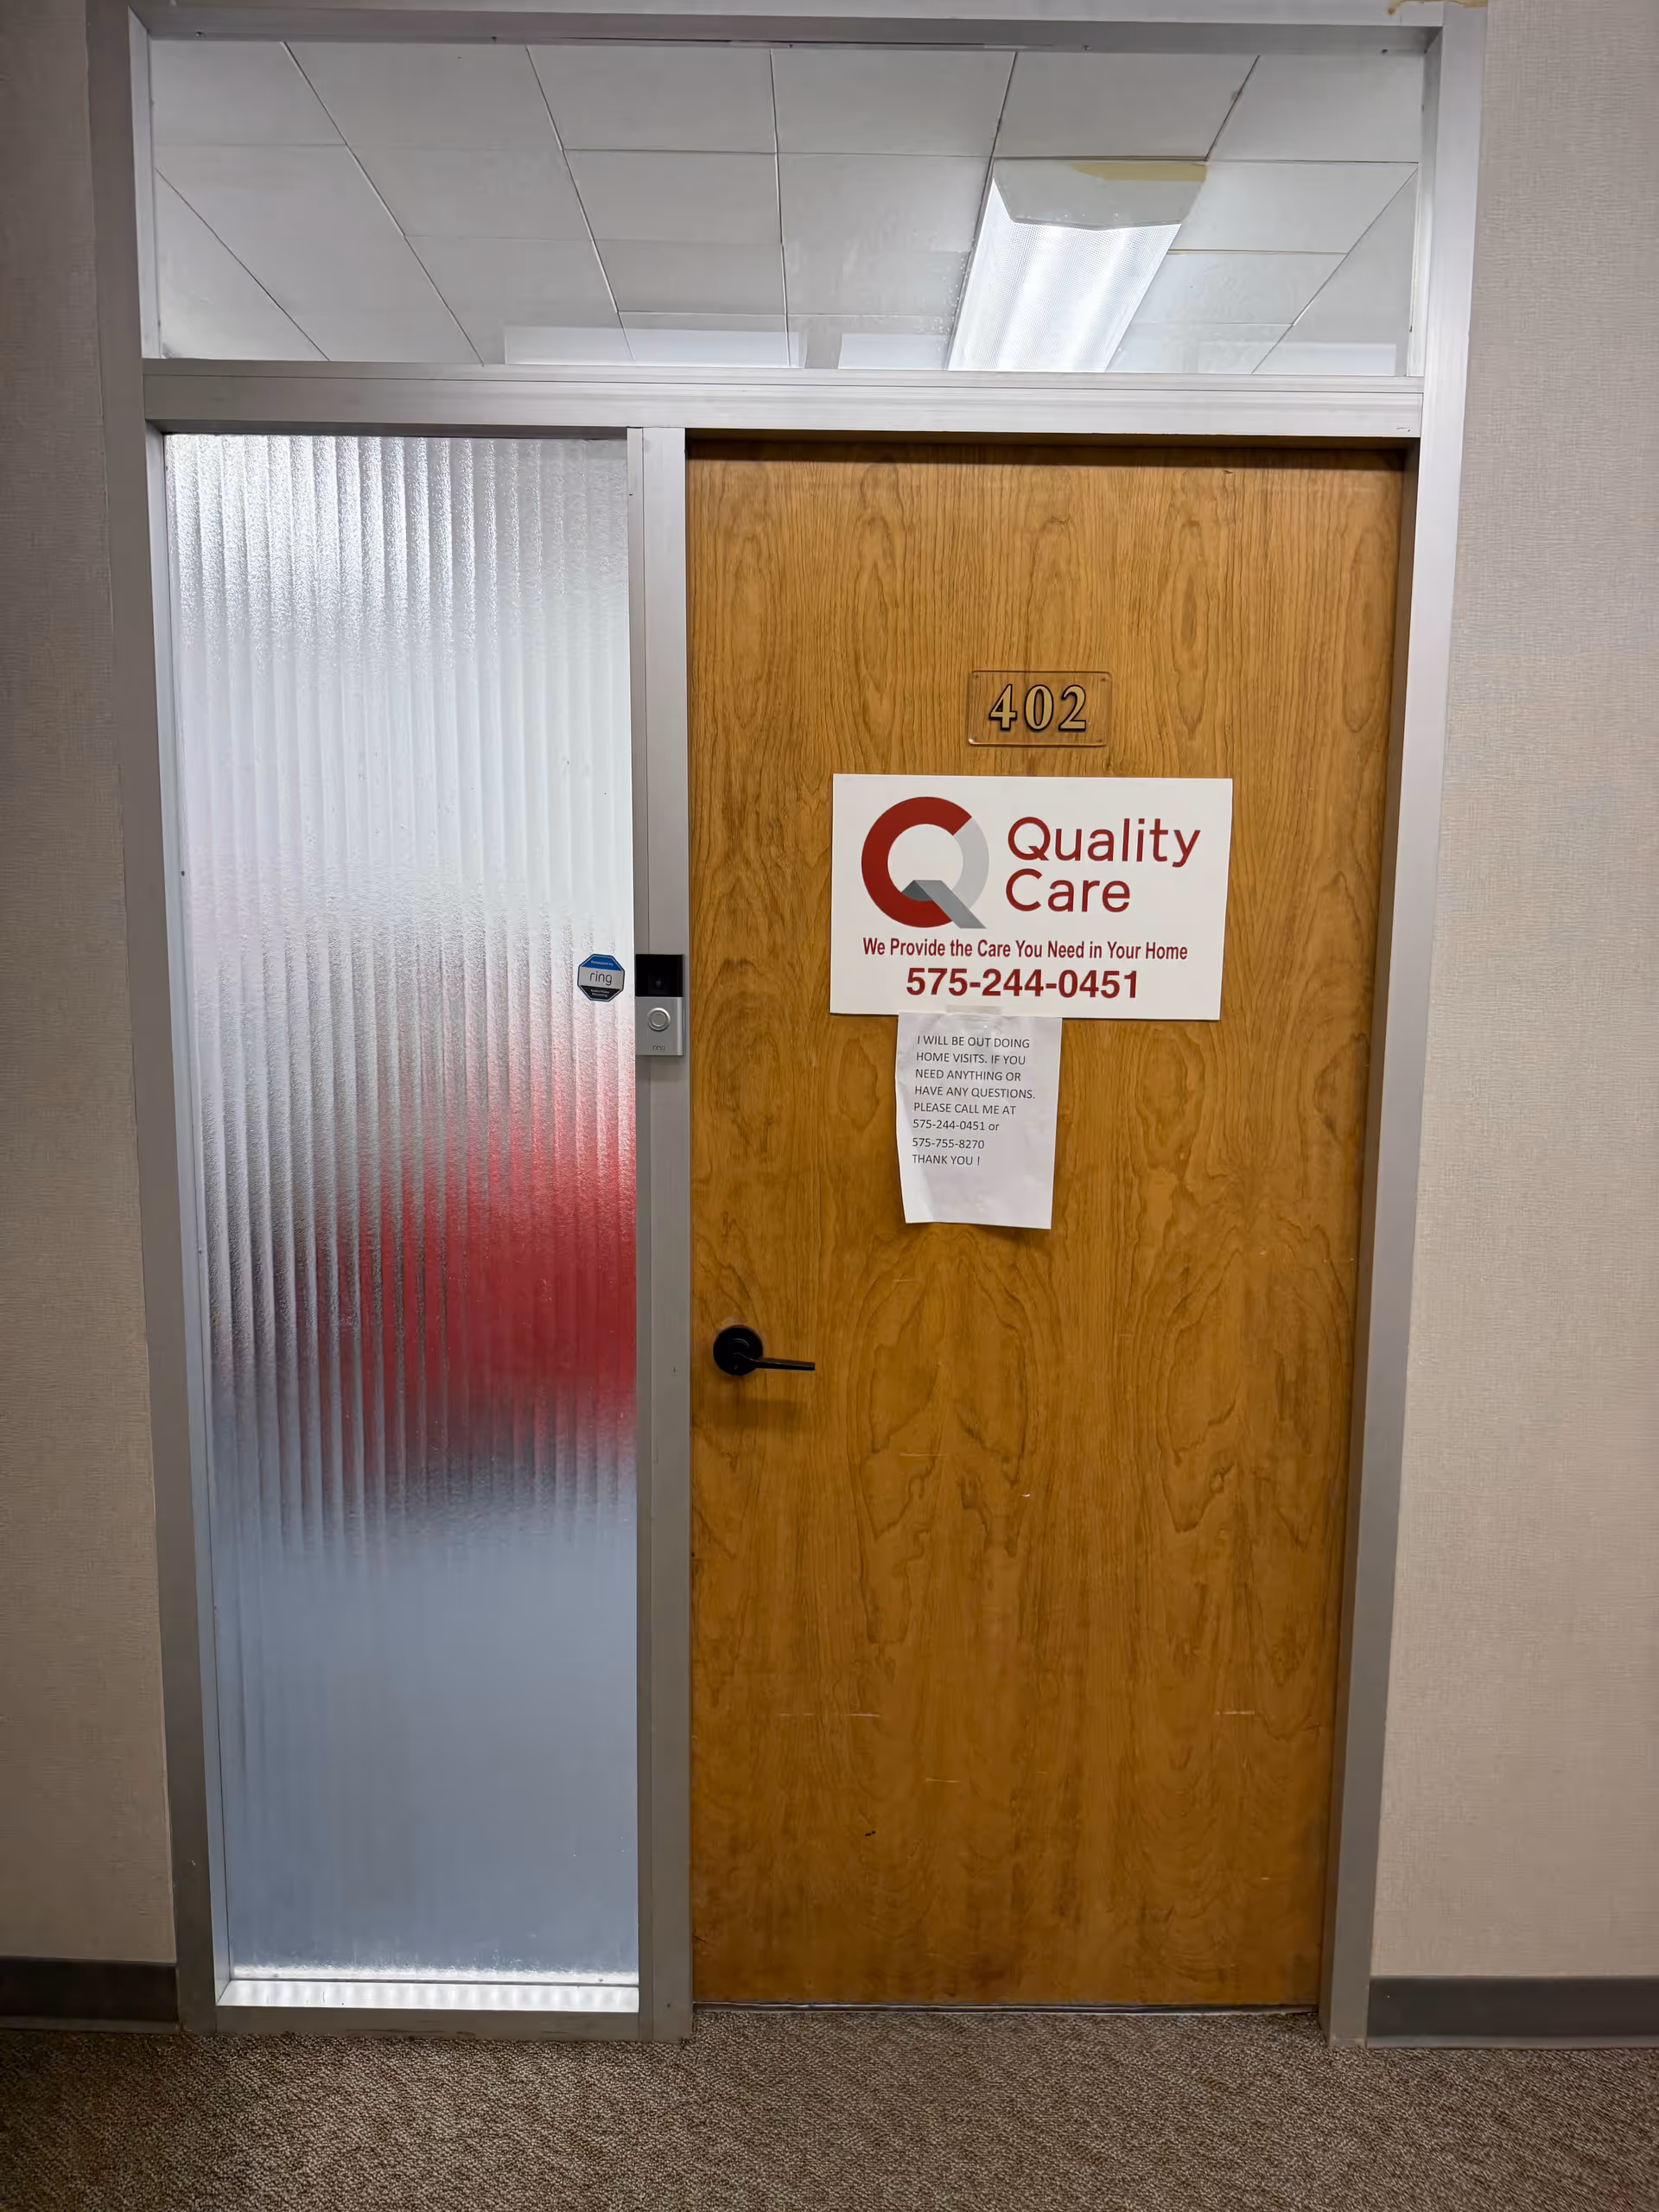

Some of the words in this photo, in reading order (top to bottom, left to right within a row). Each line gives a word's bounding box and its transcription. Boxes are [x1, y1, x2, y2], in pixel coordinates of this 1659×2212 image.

[988, 683, 1087, 731] 402
[1007, 816, 1200, 868] Quality
[1006, 868, 1130, 912] Care
[863, 938, 885, 956] We
[890, 938, 945, 957] Provide
[950, 939, 973, 957] the
[977, 940, 1010, 957] Care
[1015, 941, 1042, 958] You
[1047, 941, 1084, 959] Need
[1089, 942, 1103, 958] in
[1107, 942, 1141, 959] Your
[1146, 942, 1187, 959] Home
[589, 971, 612, 985] ring
[906, 968, 1137, 998] 575-244-0451
[917, 1036, 920, 1045] I
[924, 1036, 949, 1046] WILL
[951, 1037, 964, 1046] BE
[968, 1038, 991, 1047] OUT
[995, 1039, 1030, 1048] DOING
[916, 1052, 950, 1063] HOME
[952, 1053, 988, 1064] VISITS.
[991, 1055, 1000, 1064] IF
[1002, 1055, 1026, 1065] YOU
[916, 1069, 944, 1079] NEED
[947, 1070, 1002, 1081] ANYTHING
[1006, 1072, 1021, 1081] OR
[915, 1086, 943, 1096] HAVE
[947, 1087, 968, 1096] ANY
[971, 1088, 1035, 1099] QUESTIONS.
[914, 1103, 951, 1113] PLEASE
[954, 1104, 979, 1114] CALL
[982, 1105, 1000, 1114] ME
[1002, 1106, 1016, 1115] AT
[912, 1120, 985, 1130] 575-244-0451
[912, 1138, 984, 1148] 575-755-8270
[912, 1154, 948, 1164] THANK
[950, 1155, 973, 1165] YOU
[977, 1156, 980, 1166] !
